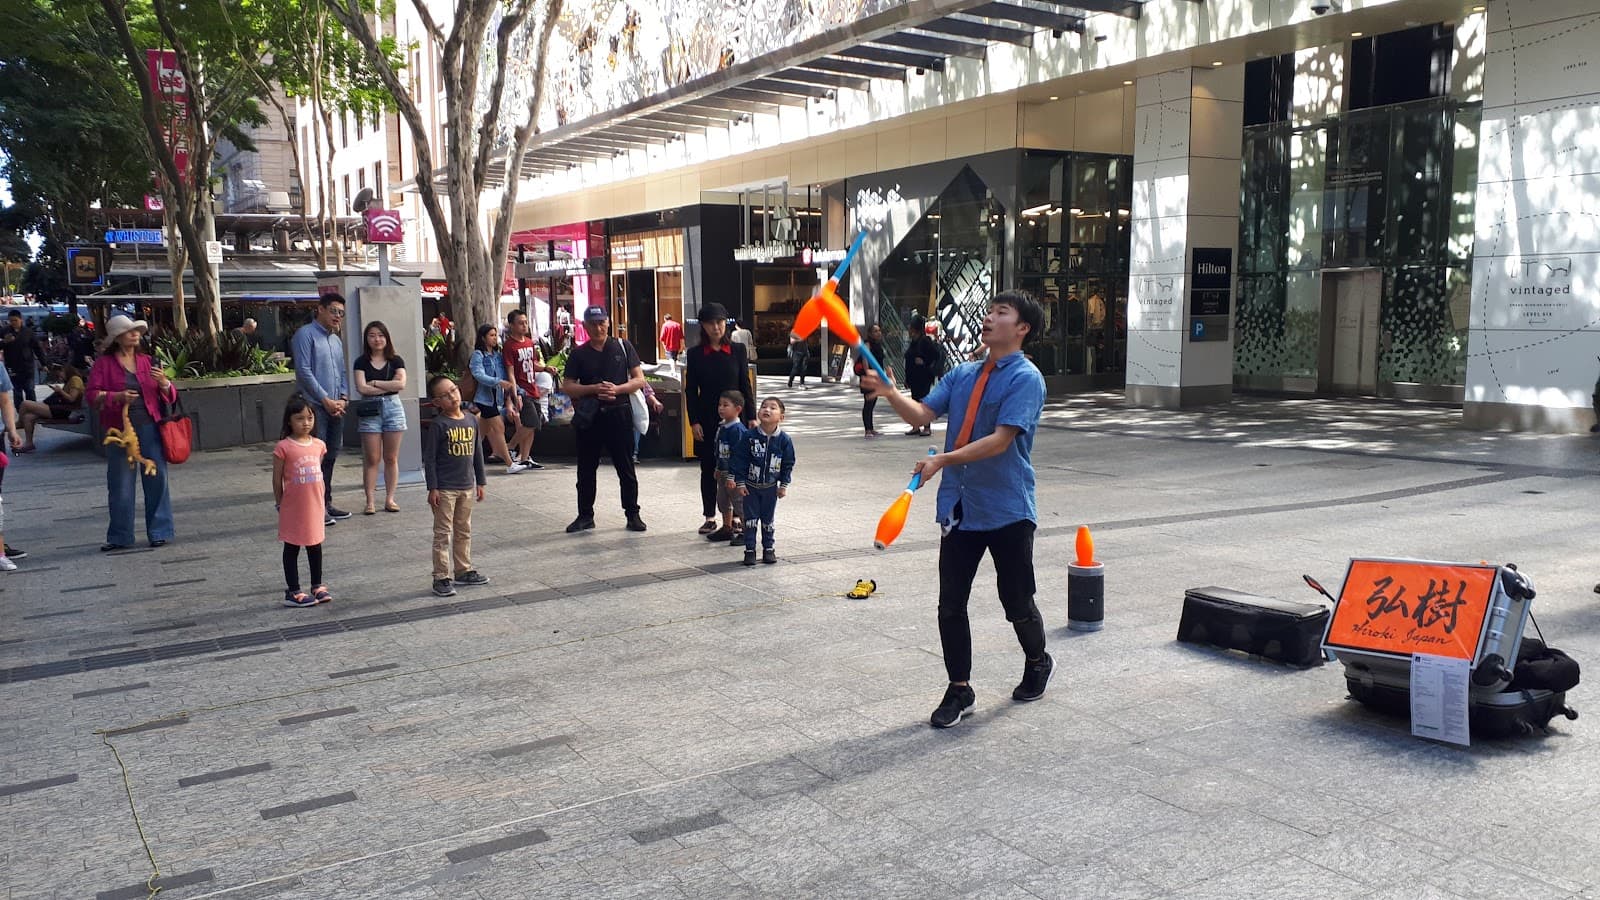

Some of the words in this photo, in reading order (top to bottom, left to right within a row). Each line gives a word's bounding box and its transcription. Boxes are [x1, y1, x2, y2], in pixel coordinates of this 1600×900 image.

[1197, 263, 1226, 274] Hilton
[1510, 284, 1570, 297] vintaged
[1139, 298, 1173, 306] vintaged
[1367, 576, 1467, 634] 弘樹
[1352, 619, 1397, 639] Hiroki
[1401, 628, 1452, 645] Japan
